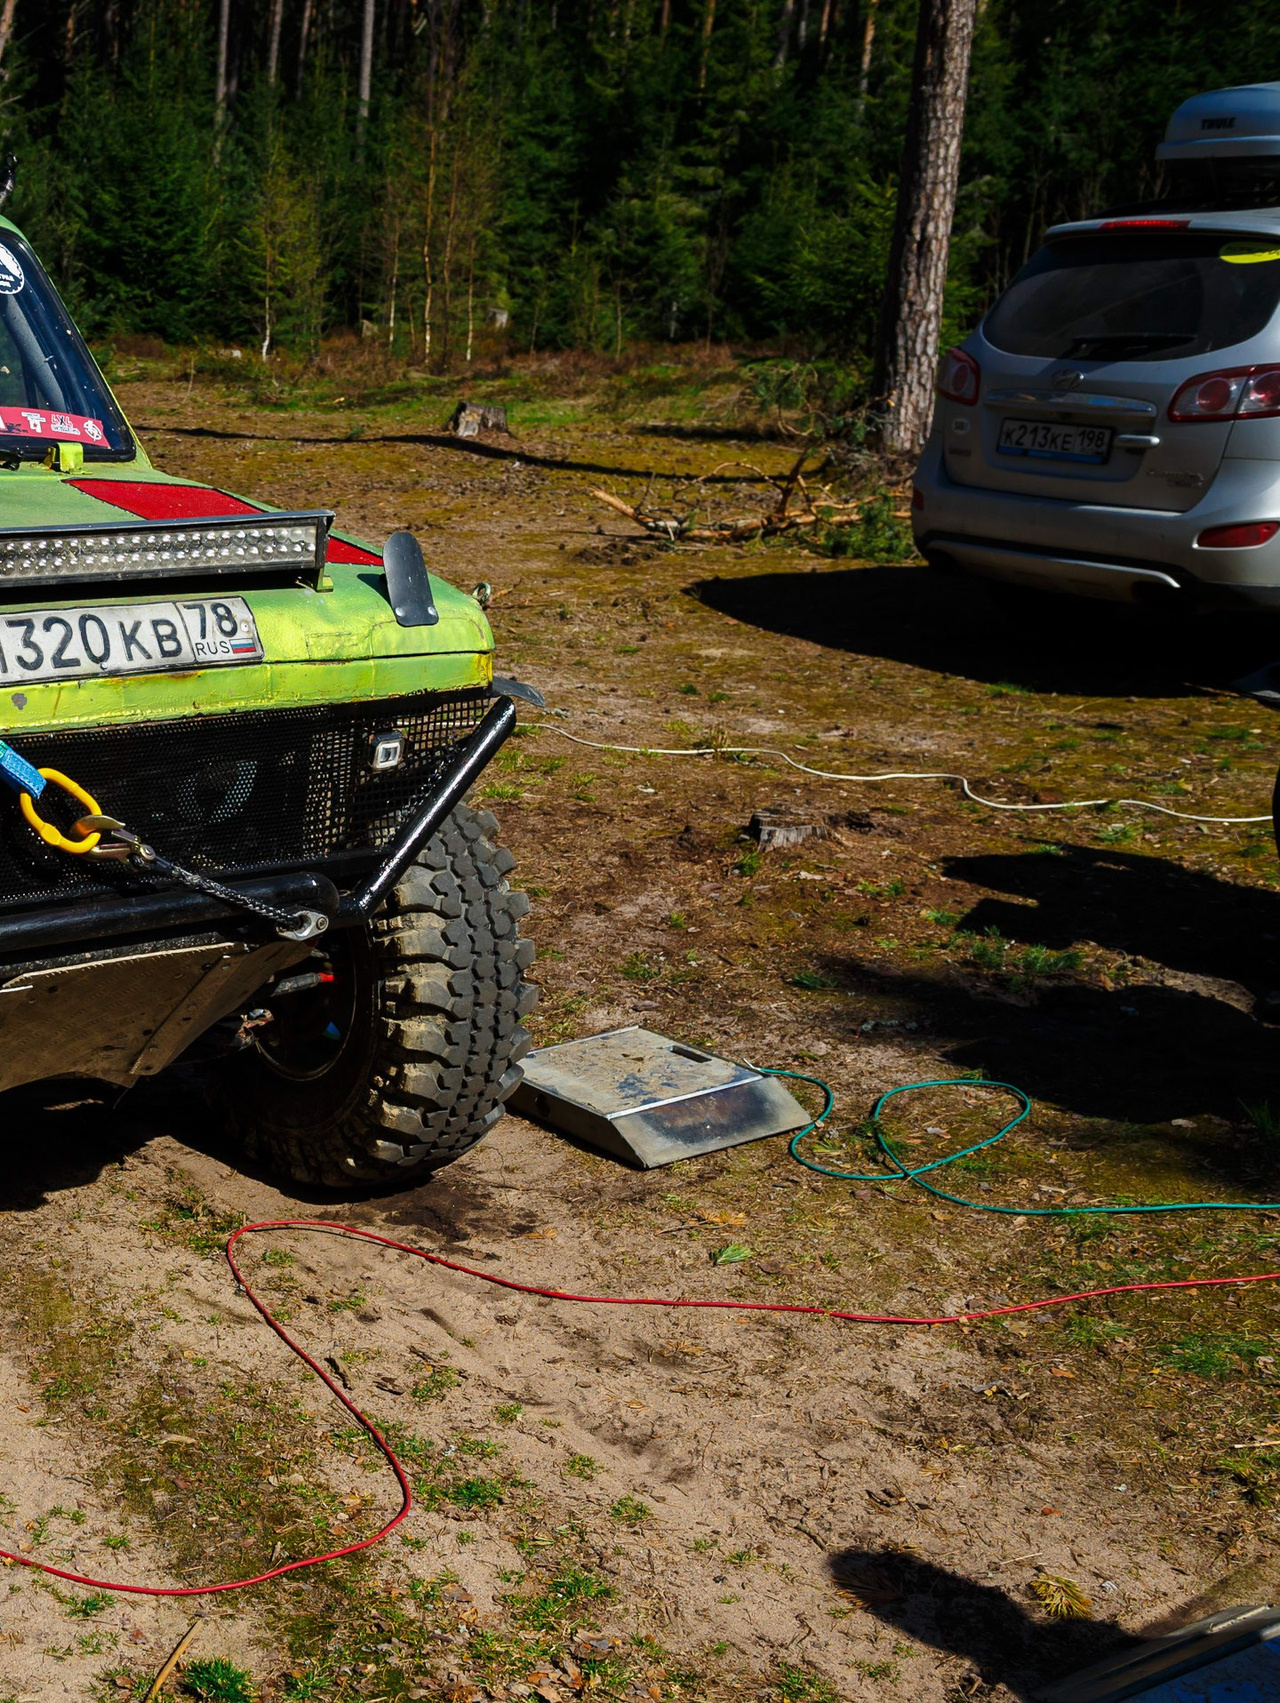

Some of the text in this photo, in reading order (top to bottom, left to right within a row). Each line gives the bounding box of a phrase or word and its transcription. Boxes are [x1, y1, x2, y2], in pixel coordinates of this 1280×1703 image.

[1003, 425, 1105, 451] К213КЕ 198
[183, 602, 239, 639] 78
[194, 639, 232, 657] RUS
